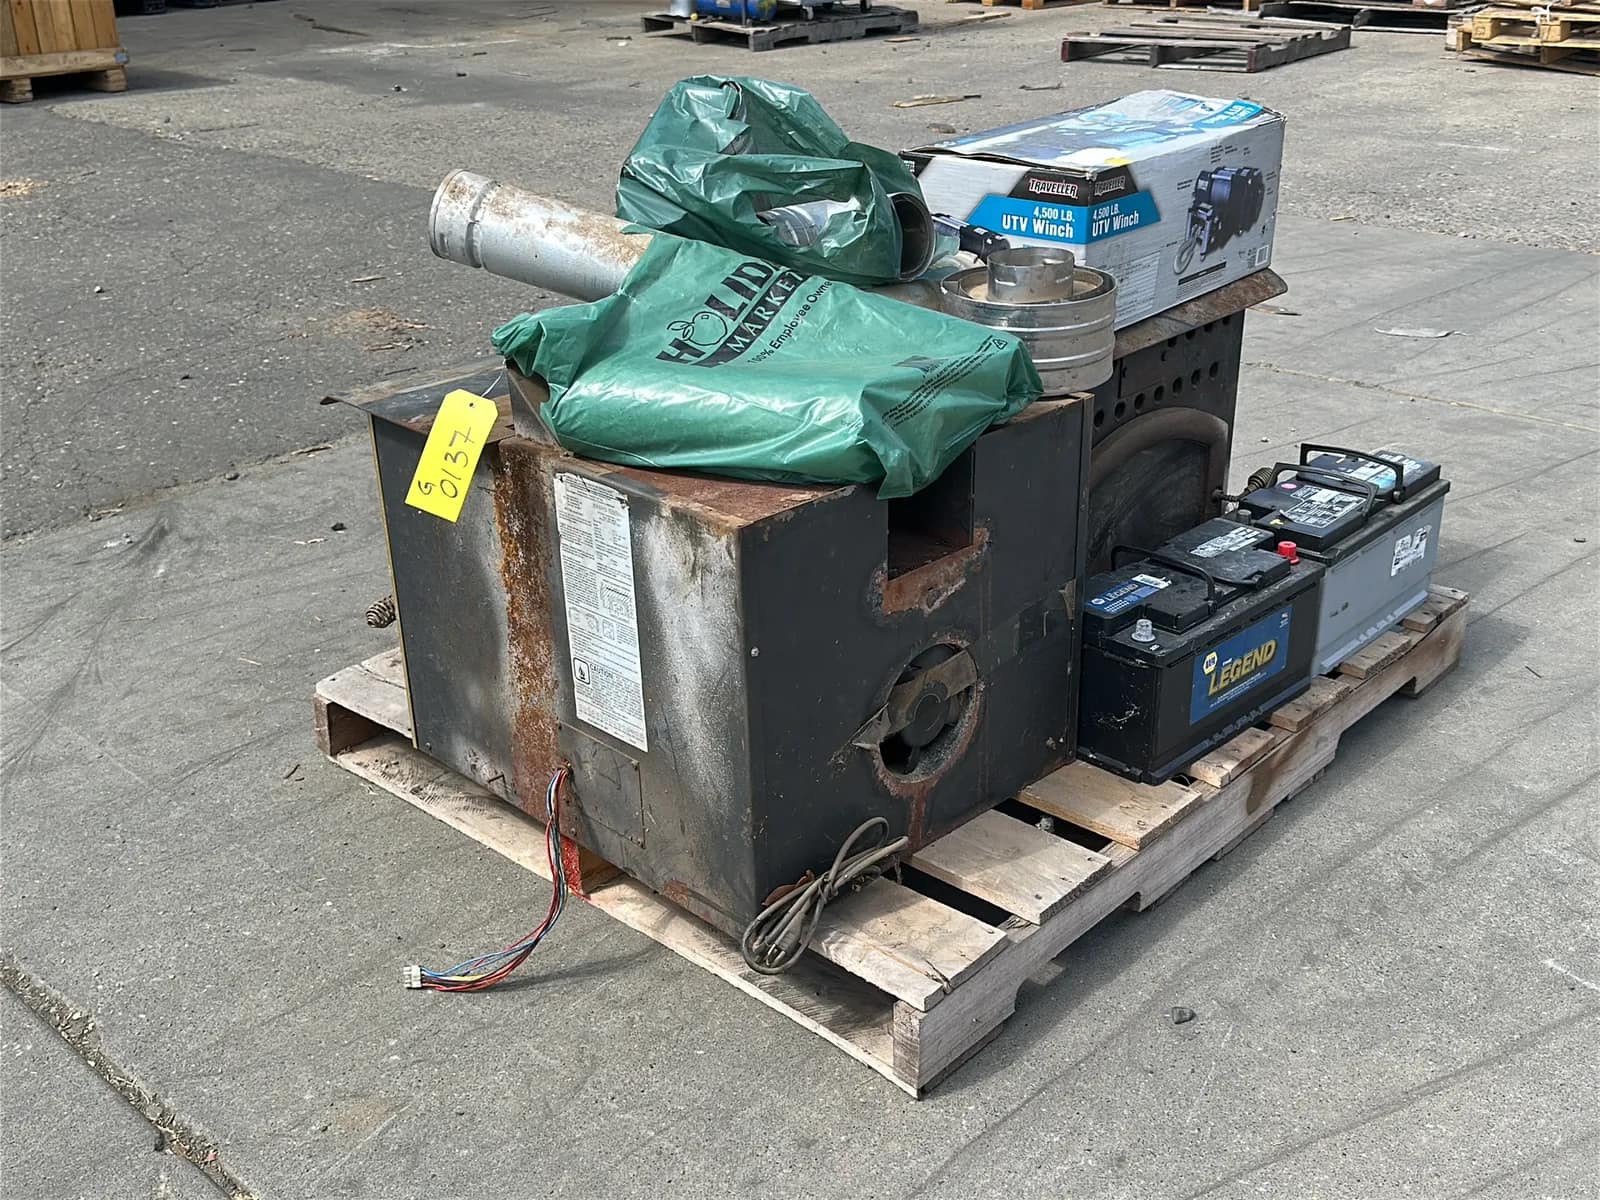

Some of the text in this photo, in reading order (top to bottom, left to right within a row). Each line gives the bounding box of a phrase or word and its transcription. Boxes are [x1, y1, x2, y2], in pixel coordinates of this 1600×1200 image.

[1028, 178, 1078, 198] TRAVELLER
[1002, 214, 1074, 239] UTV Winch
[1061, 209, 1076, 222] LB.
[1092, 210, 1139, 236] UTV Winch
[656, 260, 783, 364] HOLID
[769, 303, 811, 350] Employee
[808, 280, 833, 305] Owne
[1208, 639, 1277, 696] LEGEND
